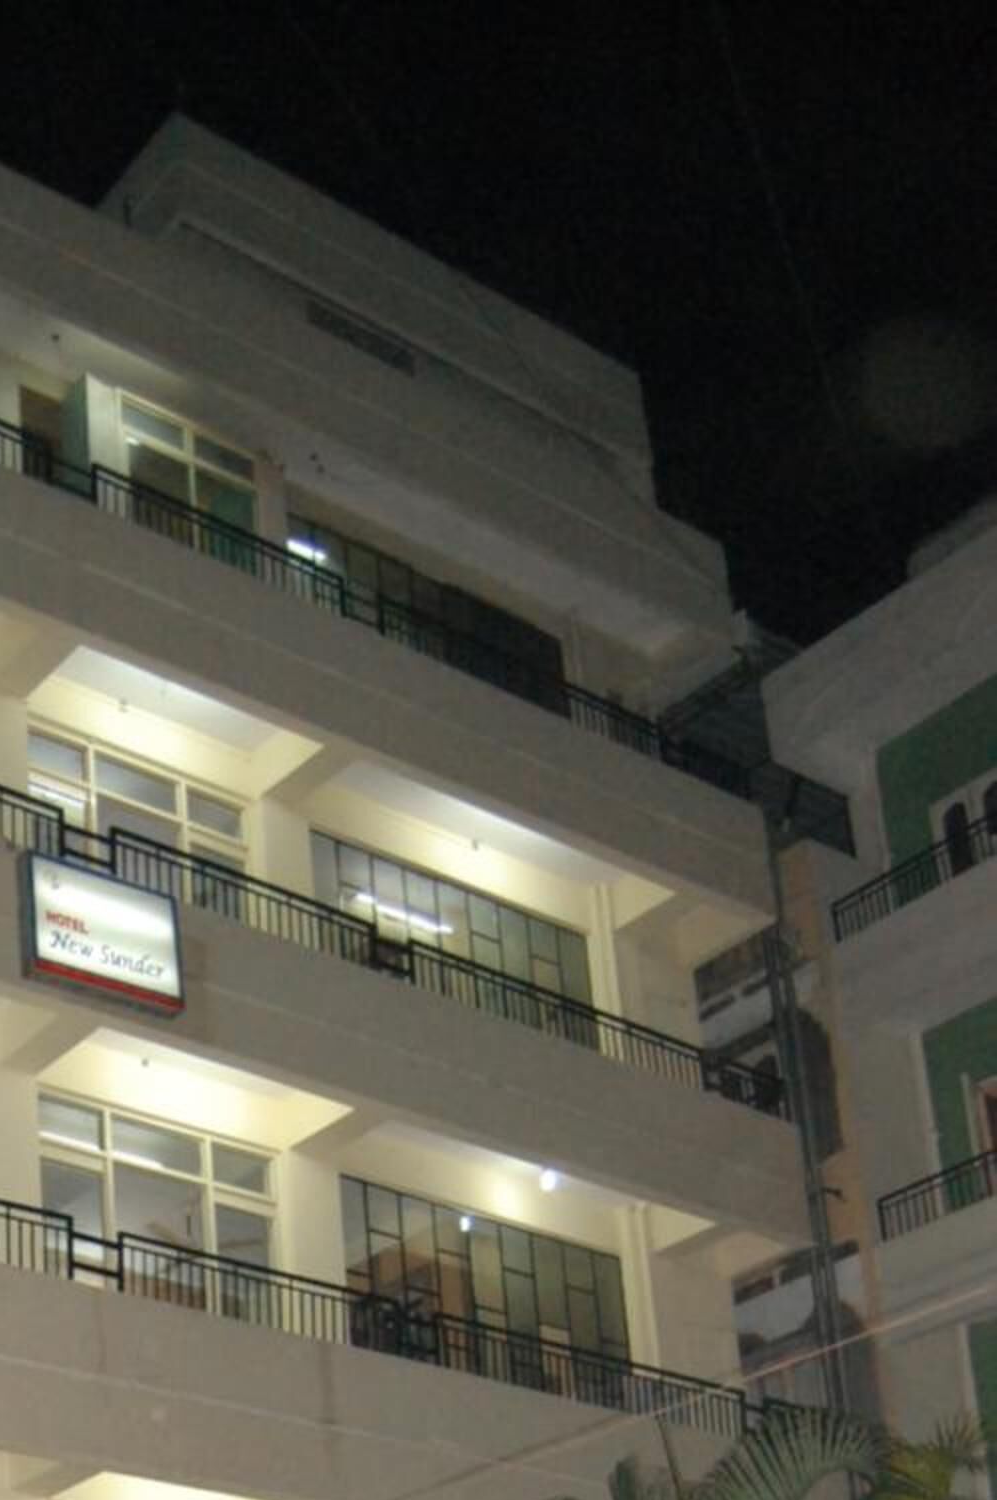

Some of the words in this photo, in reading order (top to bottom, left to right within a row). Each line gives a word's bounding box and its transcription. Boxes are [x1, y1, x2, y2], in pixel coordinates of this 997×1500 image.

[45, 910, 89, 934] HOTEL
[50, 930, 94, 957] New
[101, 944, 165, 977] Sunder
